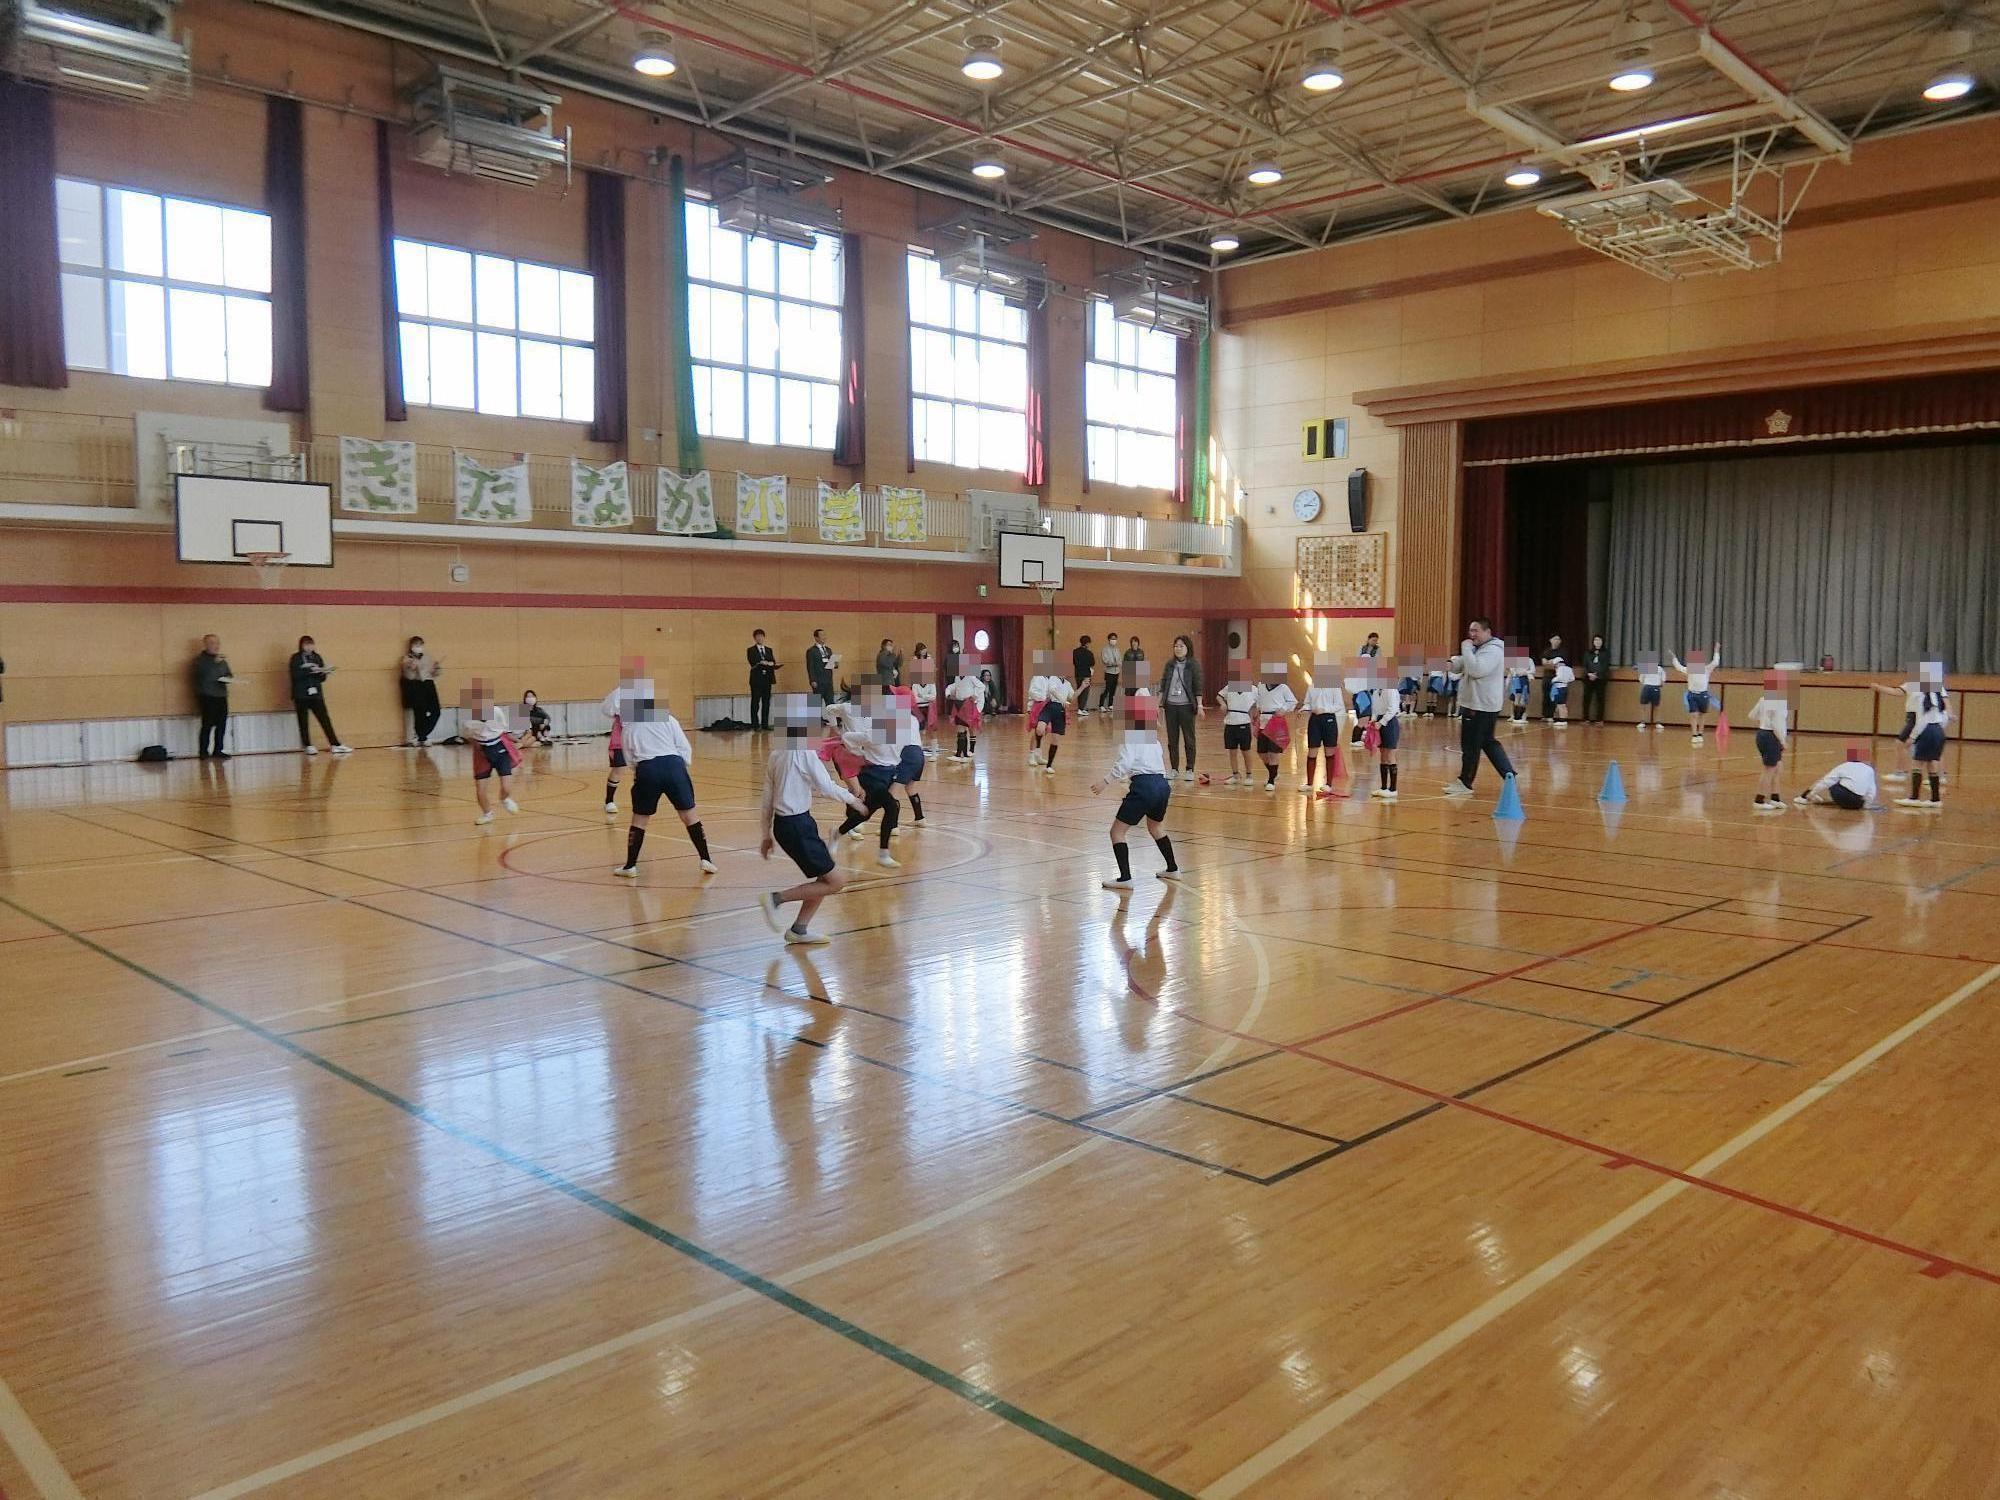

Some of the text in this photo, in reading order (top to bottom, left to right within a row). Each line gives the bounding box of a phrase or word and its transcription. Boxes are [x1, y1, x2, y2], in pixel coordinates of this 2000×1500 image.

[349, 444, 398, 509] き
[460, 465, 516, 518] た
[578, 467, 625, 524] な
[743, 483, 785, 531] 小
[823, 489, 860, 540] 学
[887, 489, 924, 539] 校
